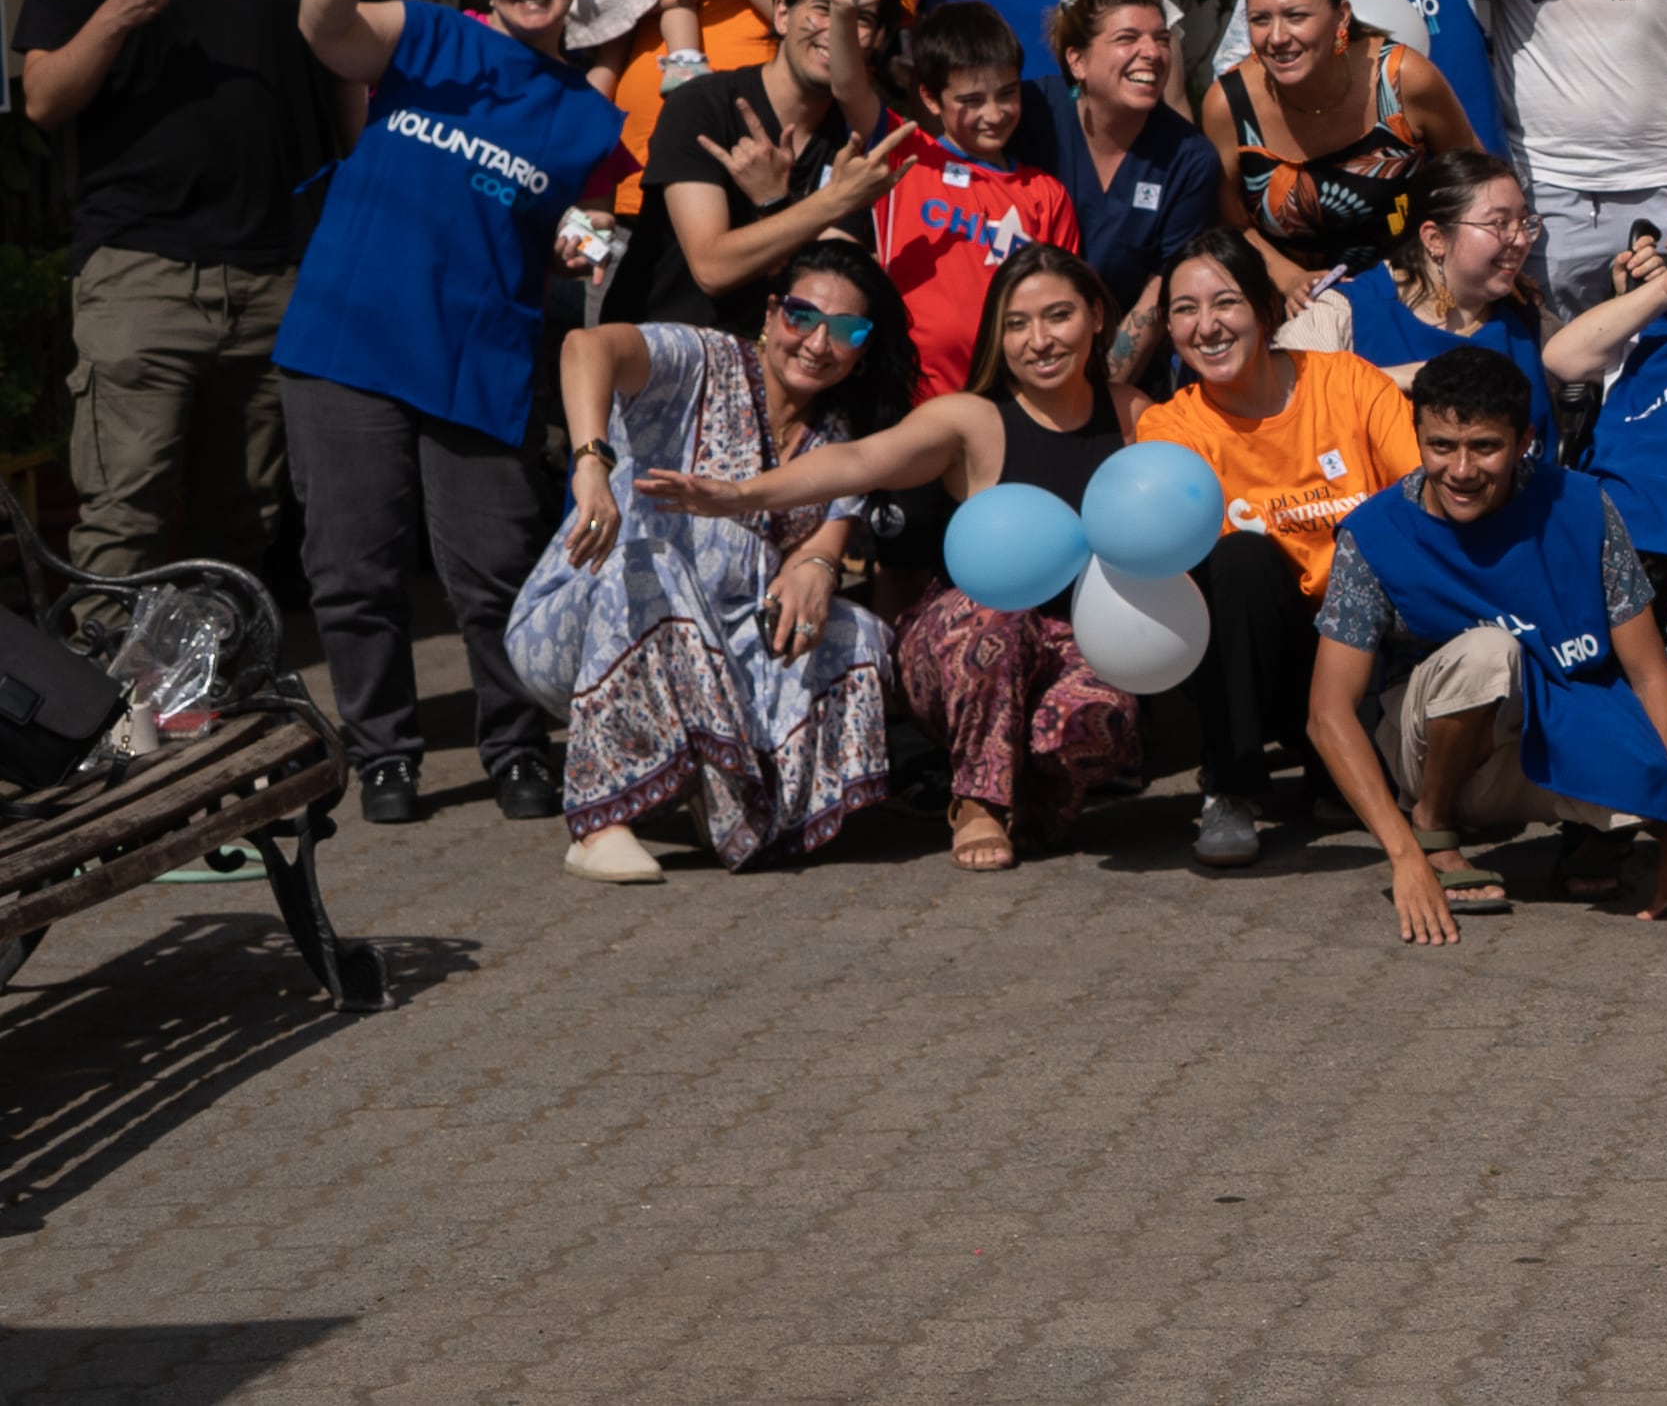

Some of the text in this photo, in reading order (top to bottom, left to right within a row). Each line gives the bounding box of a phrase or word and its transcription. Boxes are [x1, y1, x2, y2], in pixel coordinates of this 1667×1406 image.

[386, 109, 550, 196] VOLUNTARIO
[1270, 486, 1335, 509] DÍA DEL
